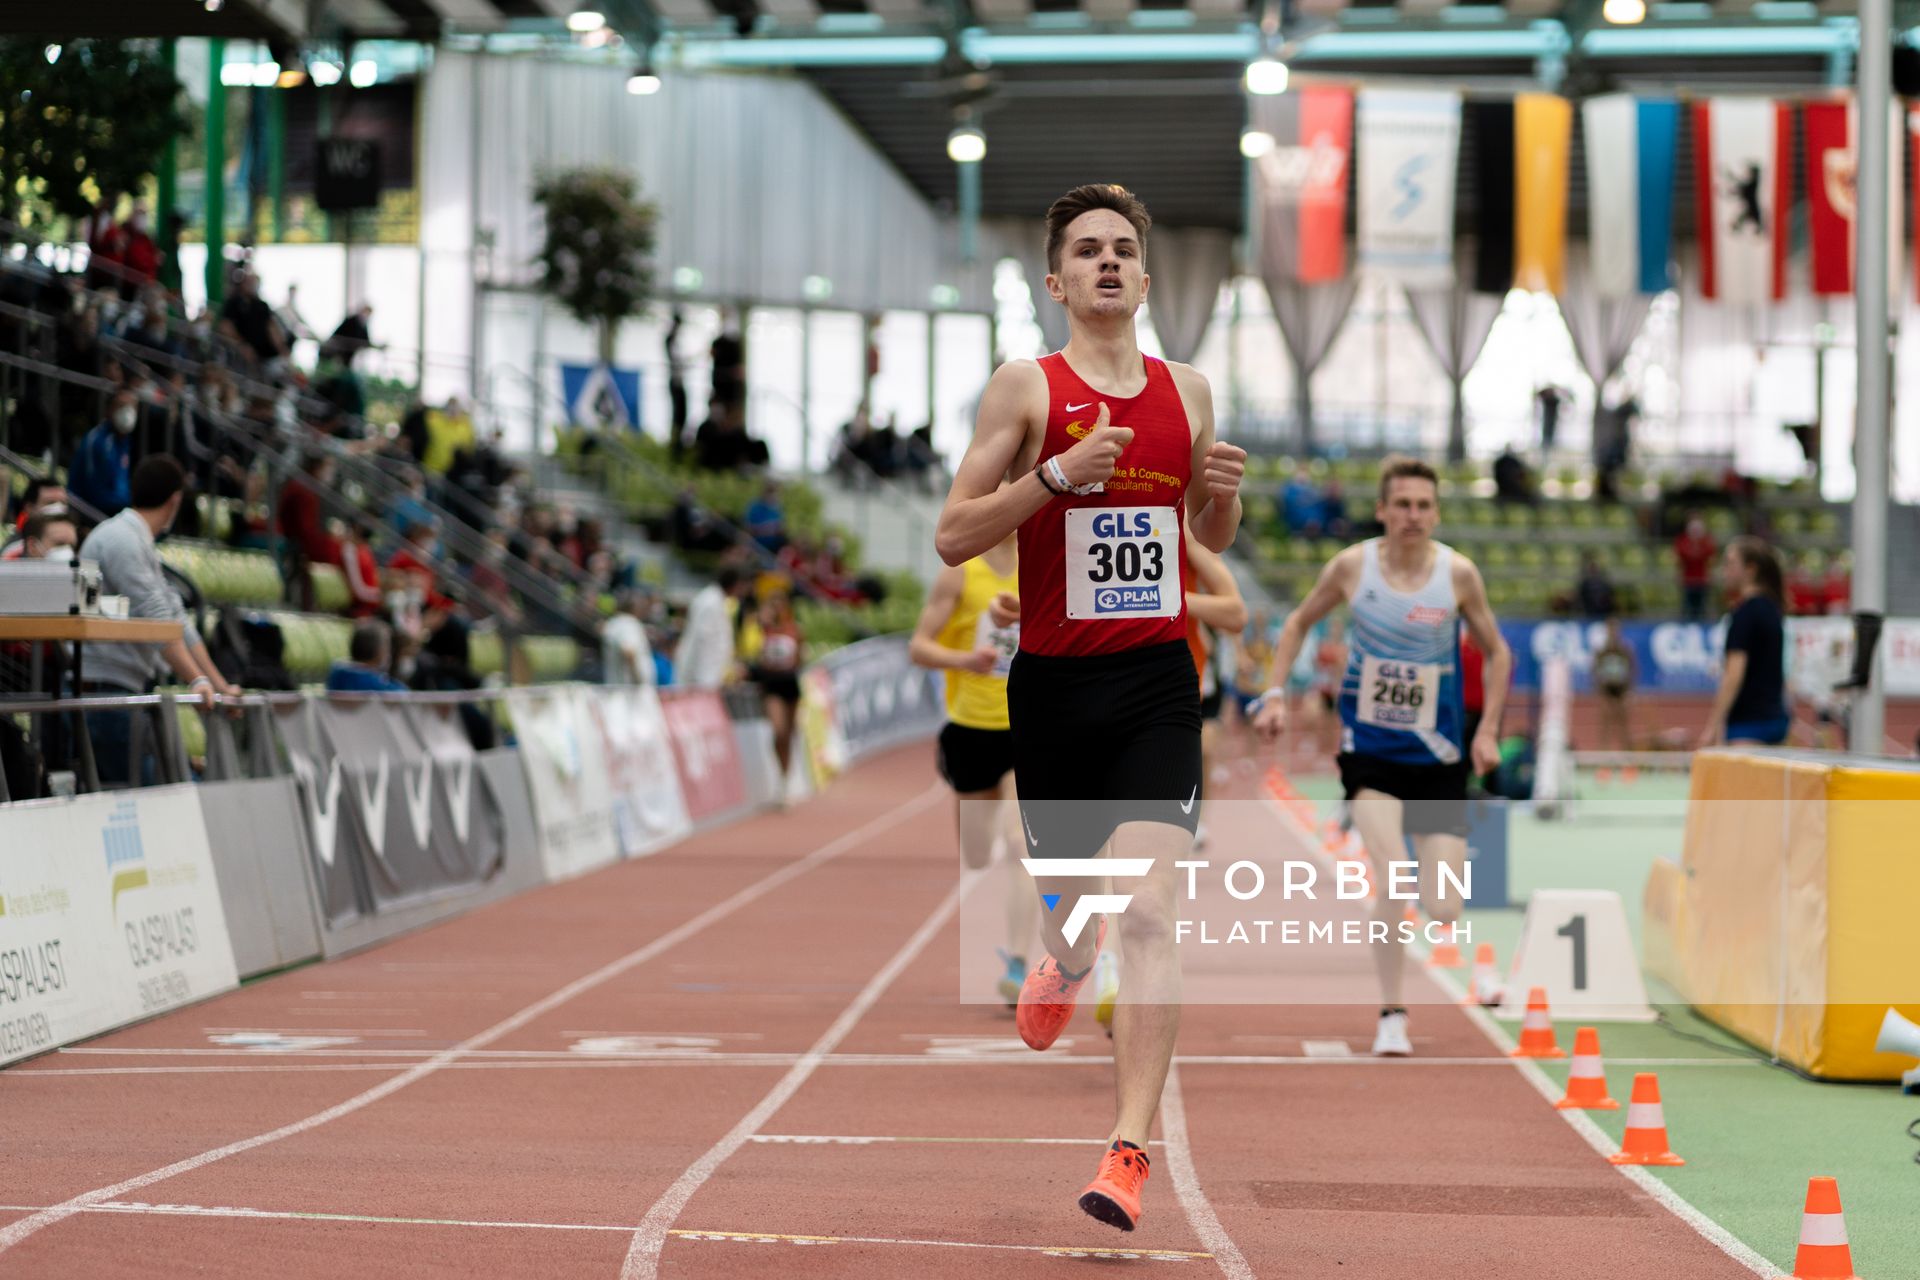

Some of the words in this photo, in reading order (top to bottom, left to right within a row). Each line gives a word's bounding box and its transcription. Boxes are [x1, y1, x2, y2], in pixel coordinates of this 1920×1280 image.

[1104, 480, 1154, 492] onsultants
[1129, 467, 1137, 477] &
[1088, 541, 1164, 583] 303
[1123, 590, 1159, 602] PLAN
[1374, 679, 1425, 707] 266
[123, 906, 197, 968] GLASPALAST
[1557, 915, 1587, 990] 1
